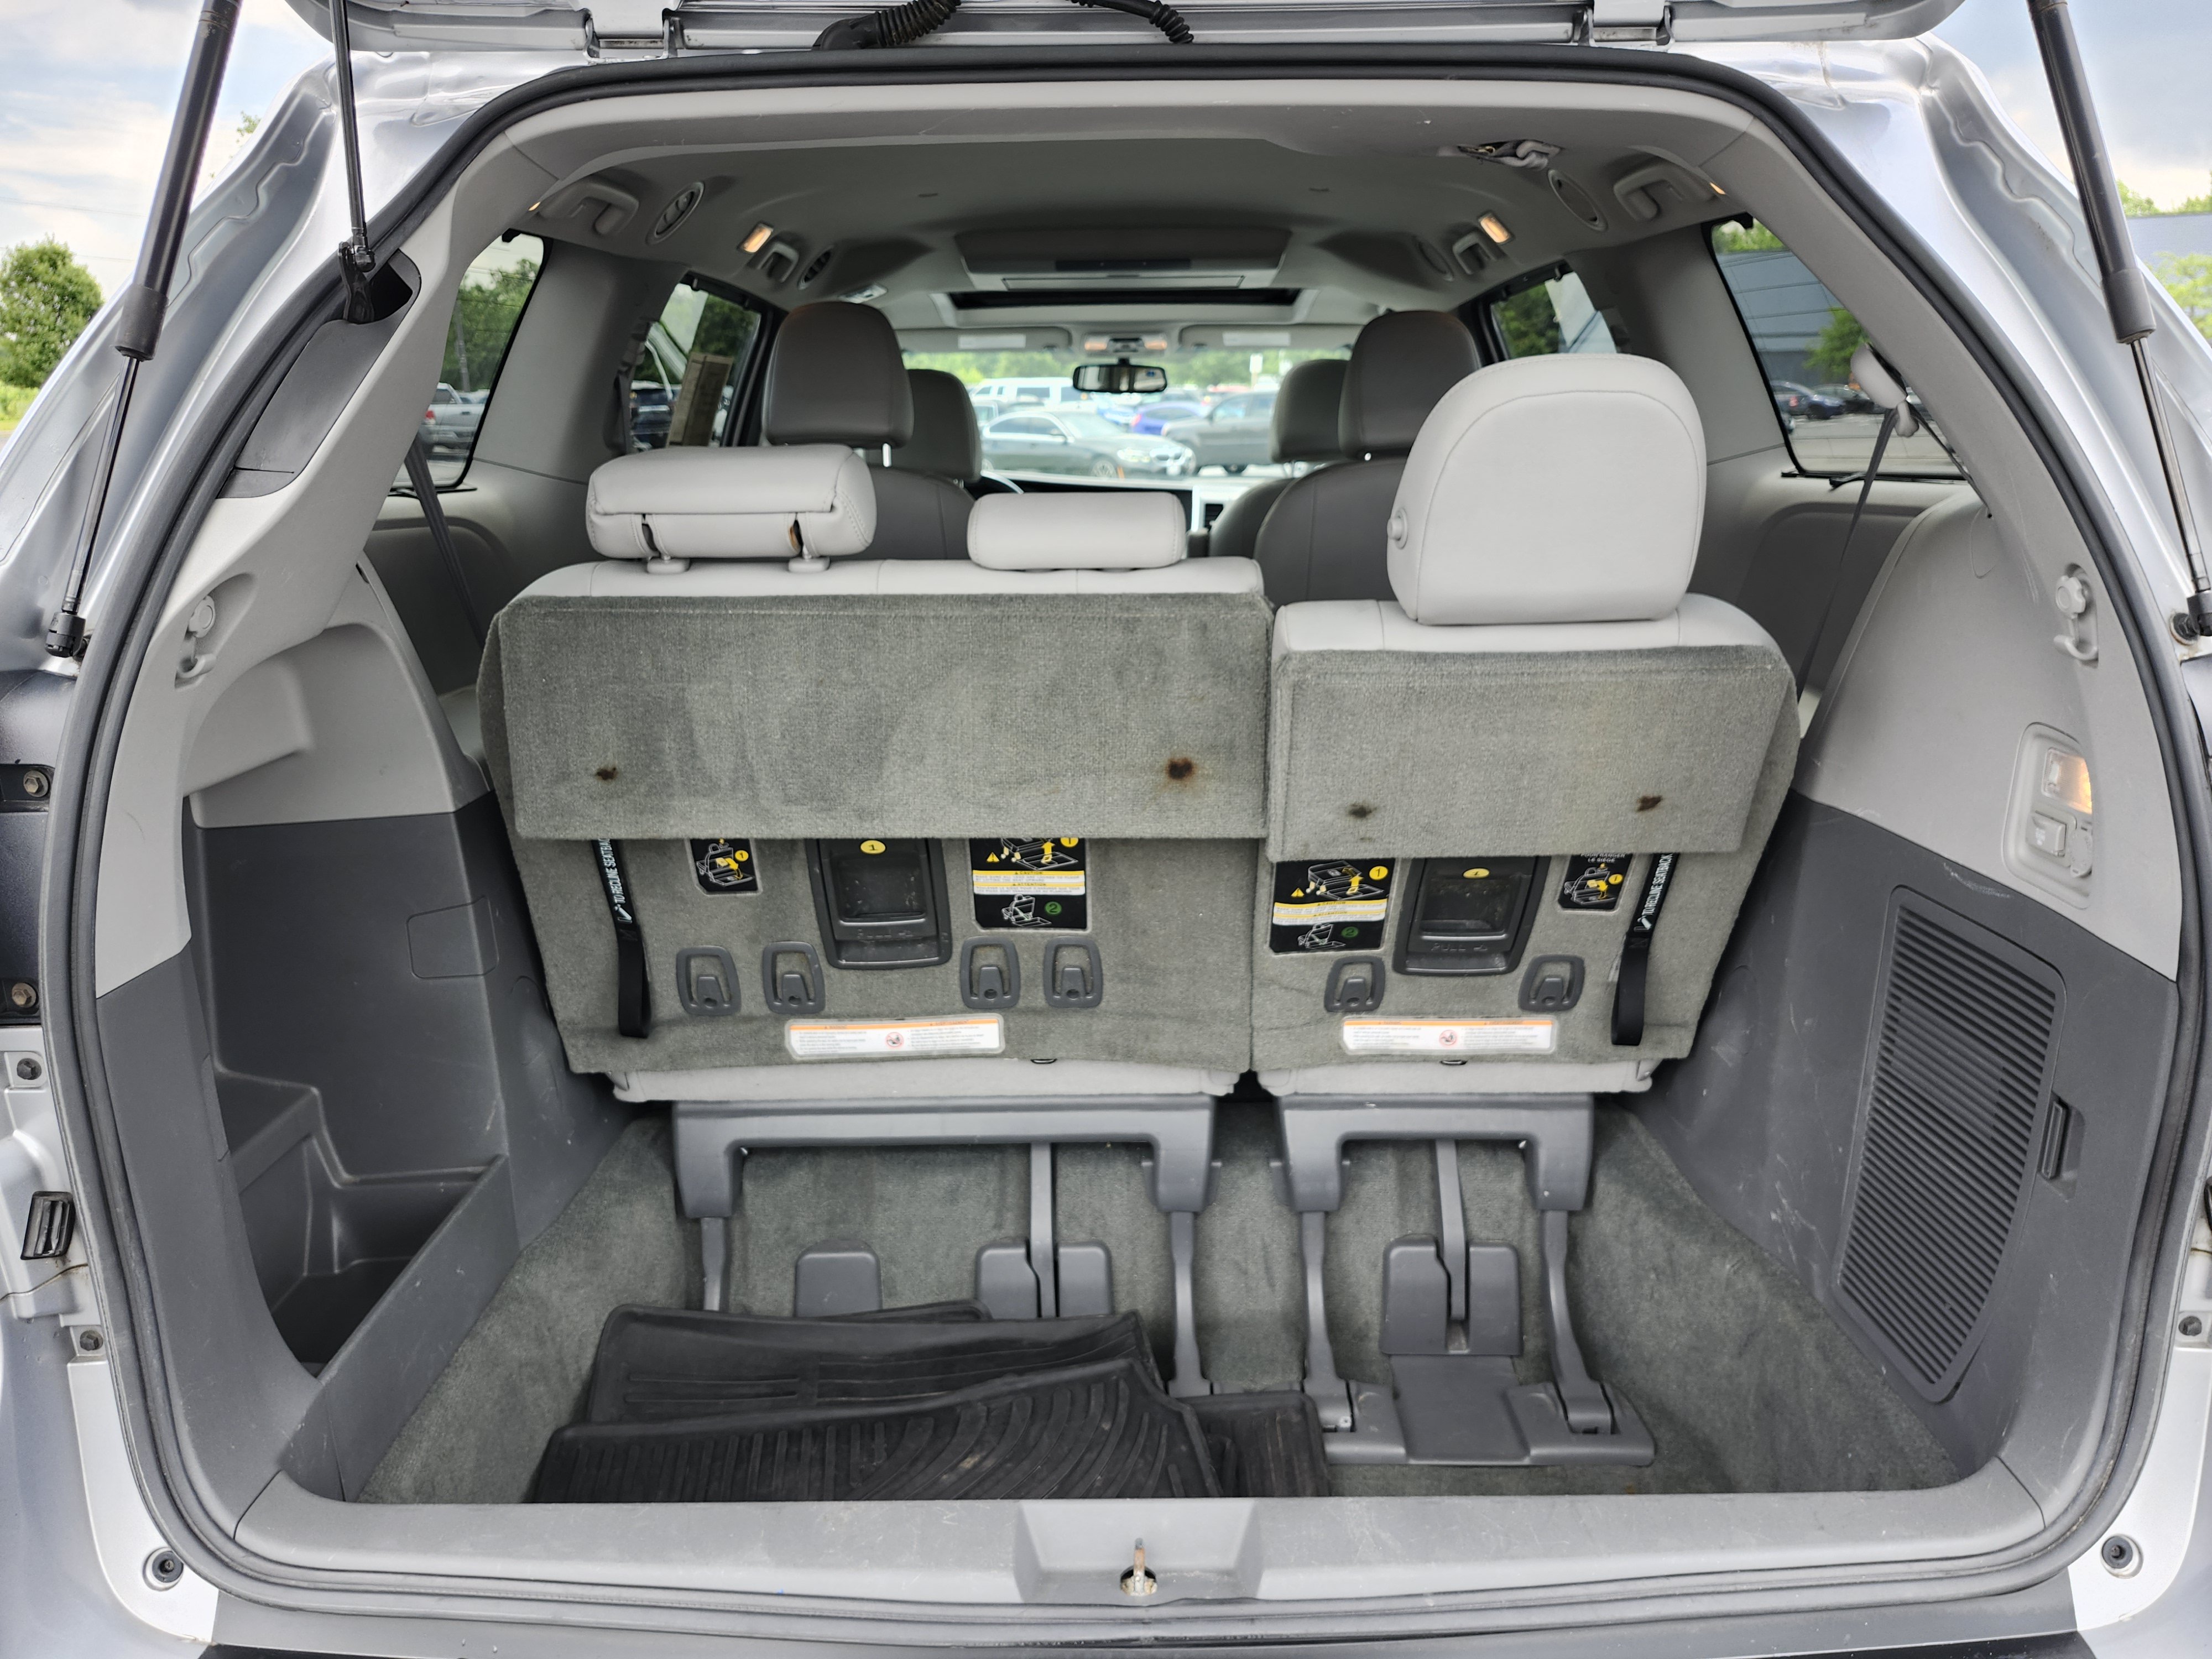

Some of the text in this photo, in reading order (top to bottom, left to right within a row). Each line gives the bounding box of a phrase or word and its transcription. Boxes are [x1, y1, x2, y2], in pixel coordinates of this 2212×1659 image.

[597, 838, 616, 867] SEATBAC
[613, 894, 626, 904] TO
[1641, 906, 1656, 916] TO
